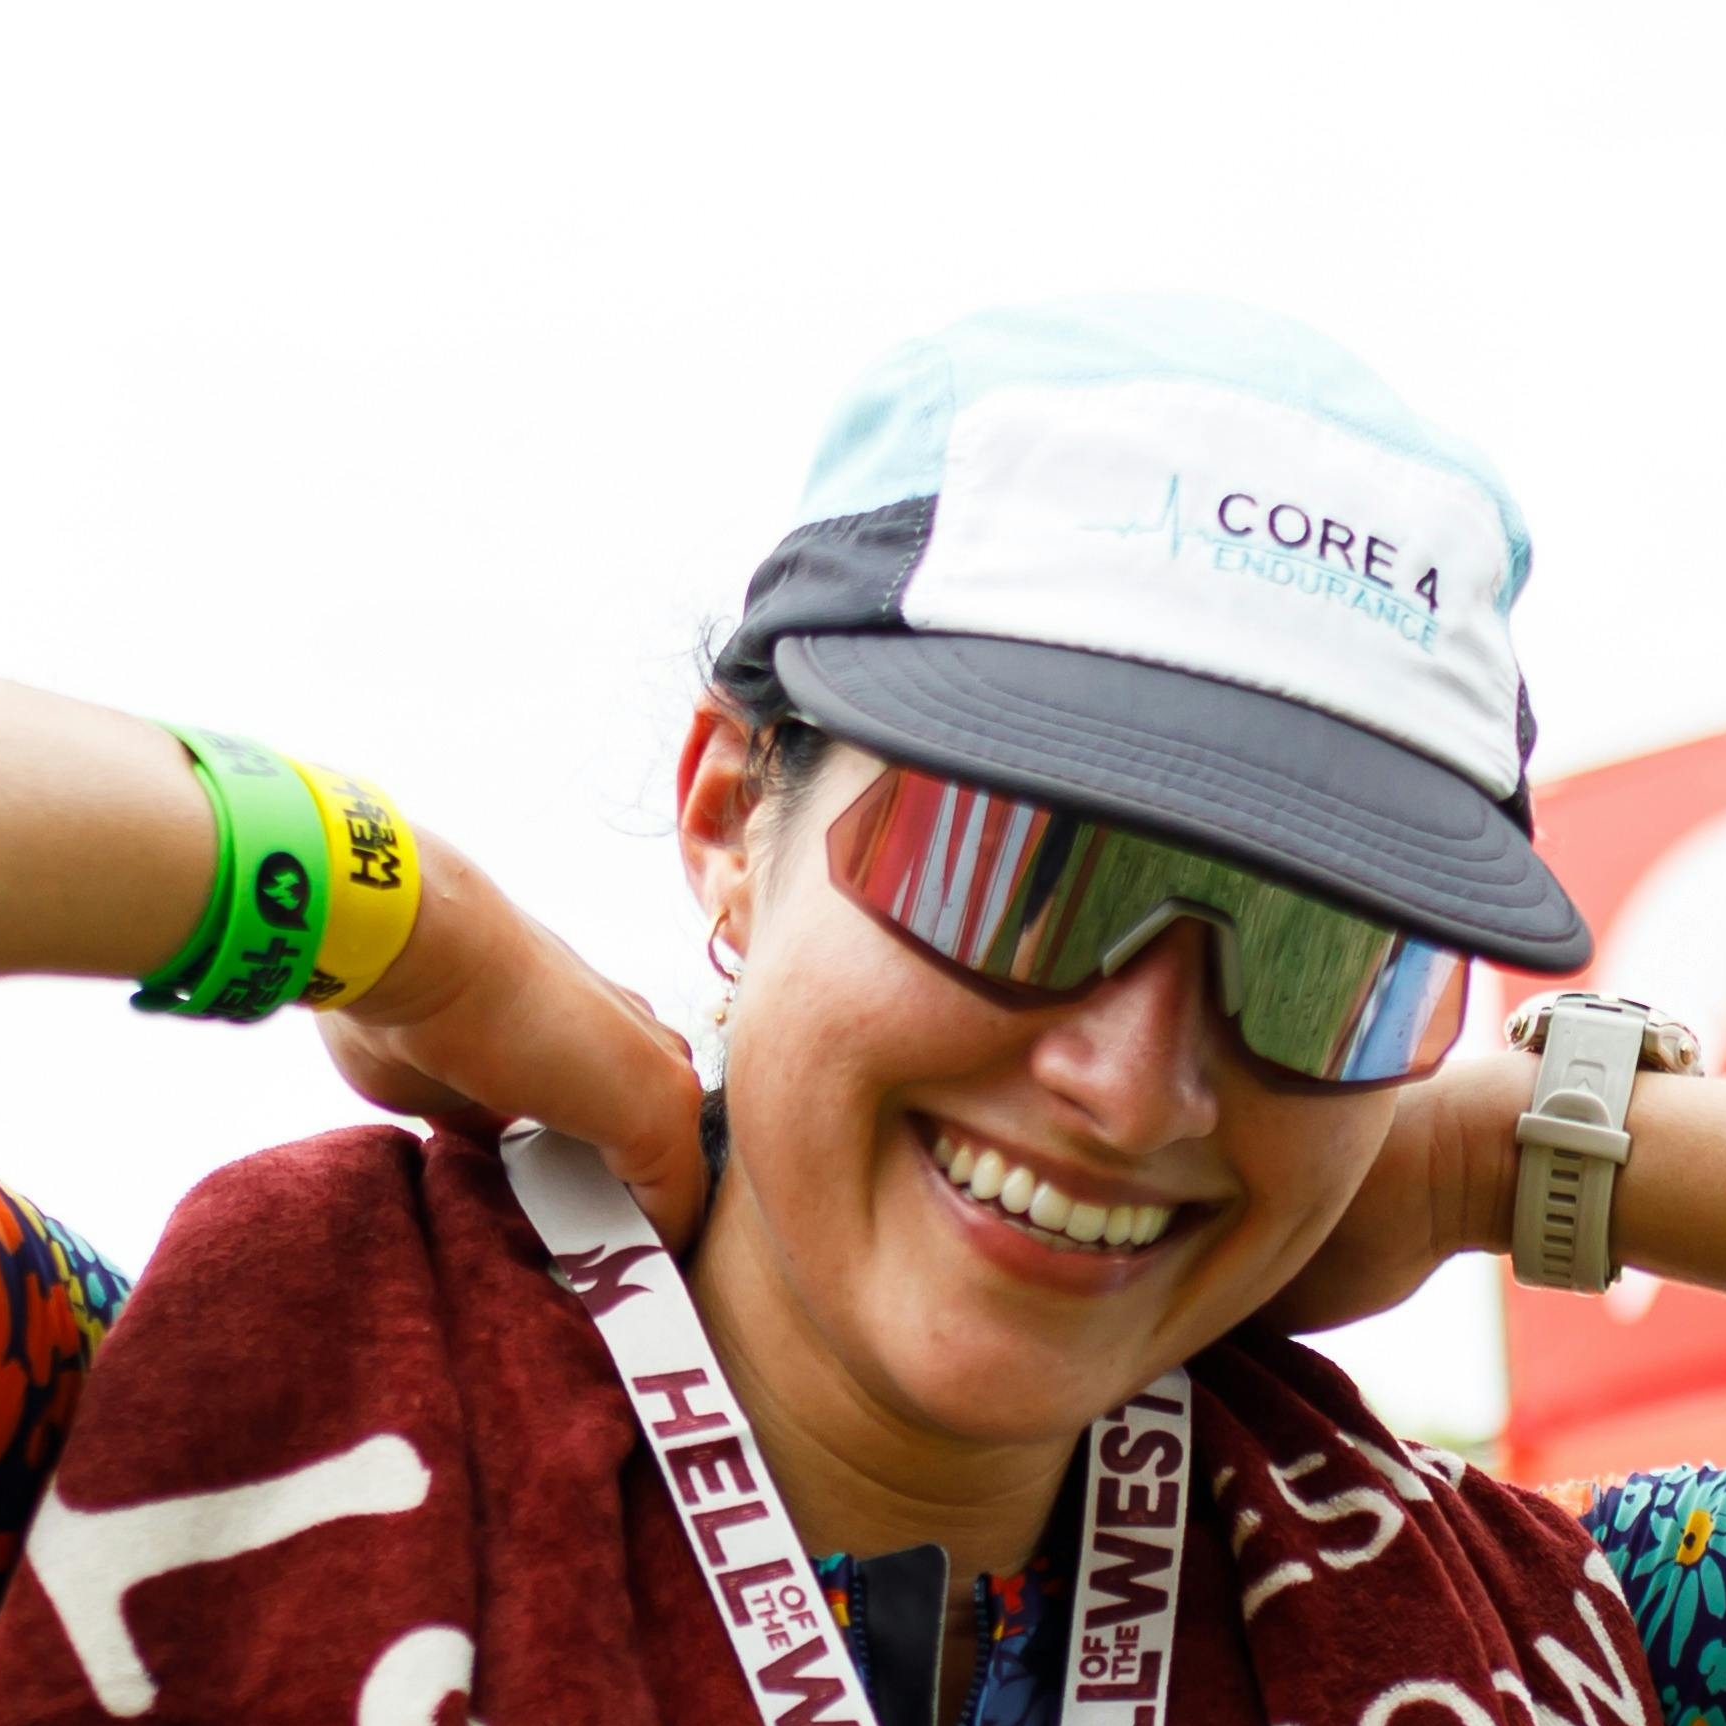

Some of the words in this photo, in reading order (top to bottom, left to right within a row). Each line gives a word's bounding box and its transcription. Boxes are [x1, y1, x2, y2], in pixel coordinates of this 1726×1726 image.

[1218, 493, 1399, 591] CORE
[1414, 566, 1440, 617] 4
[1211, 545, 1441, 656] ENDURANCE
[630, 1366, 795, 1629] HELL
[749, 1588, 795, 1652] THE
[781, 1571, 820, 1630] OF
[1078, 1636, 1111, 1680] OF
[1111, 1623, 1141, 1681] THE
